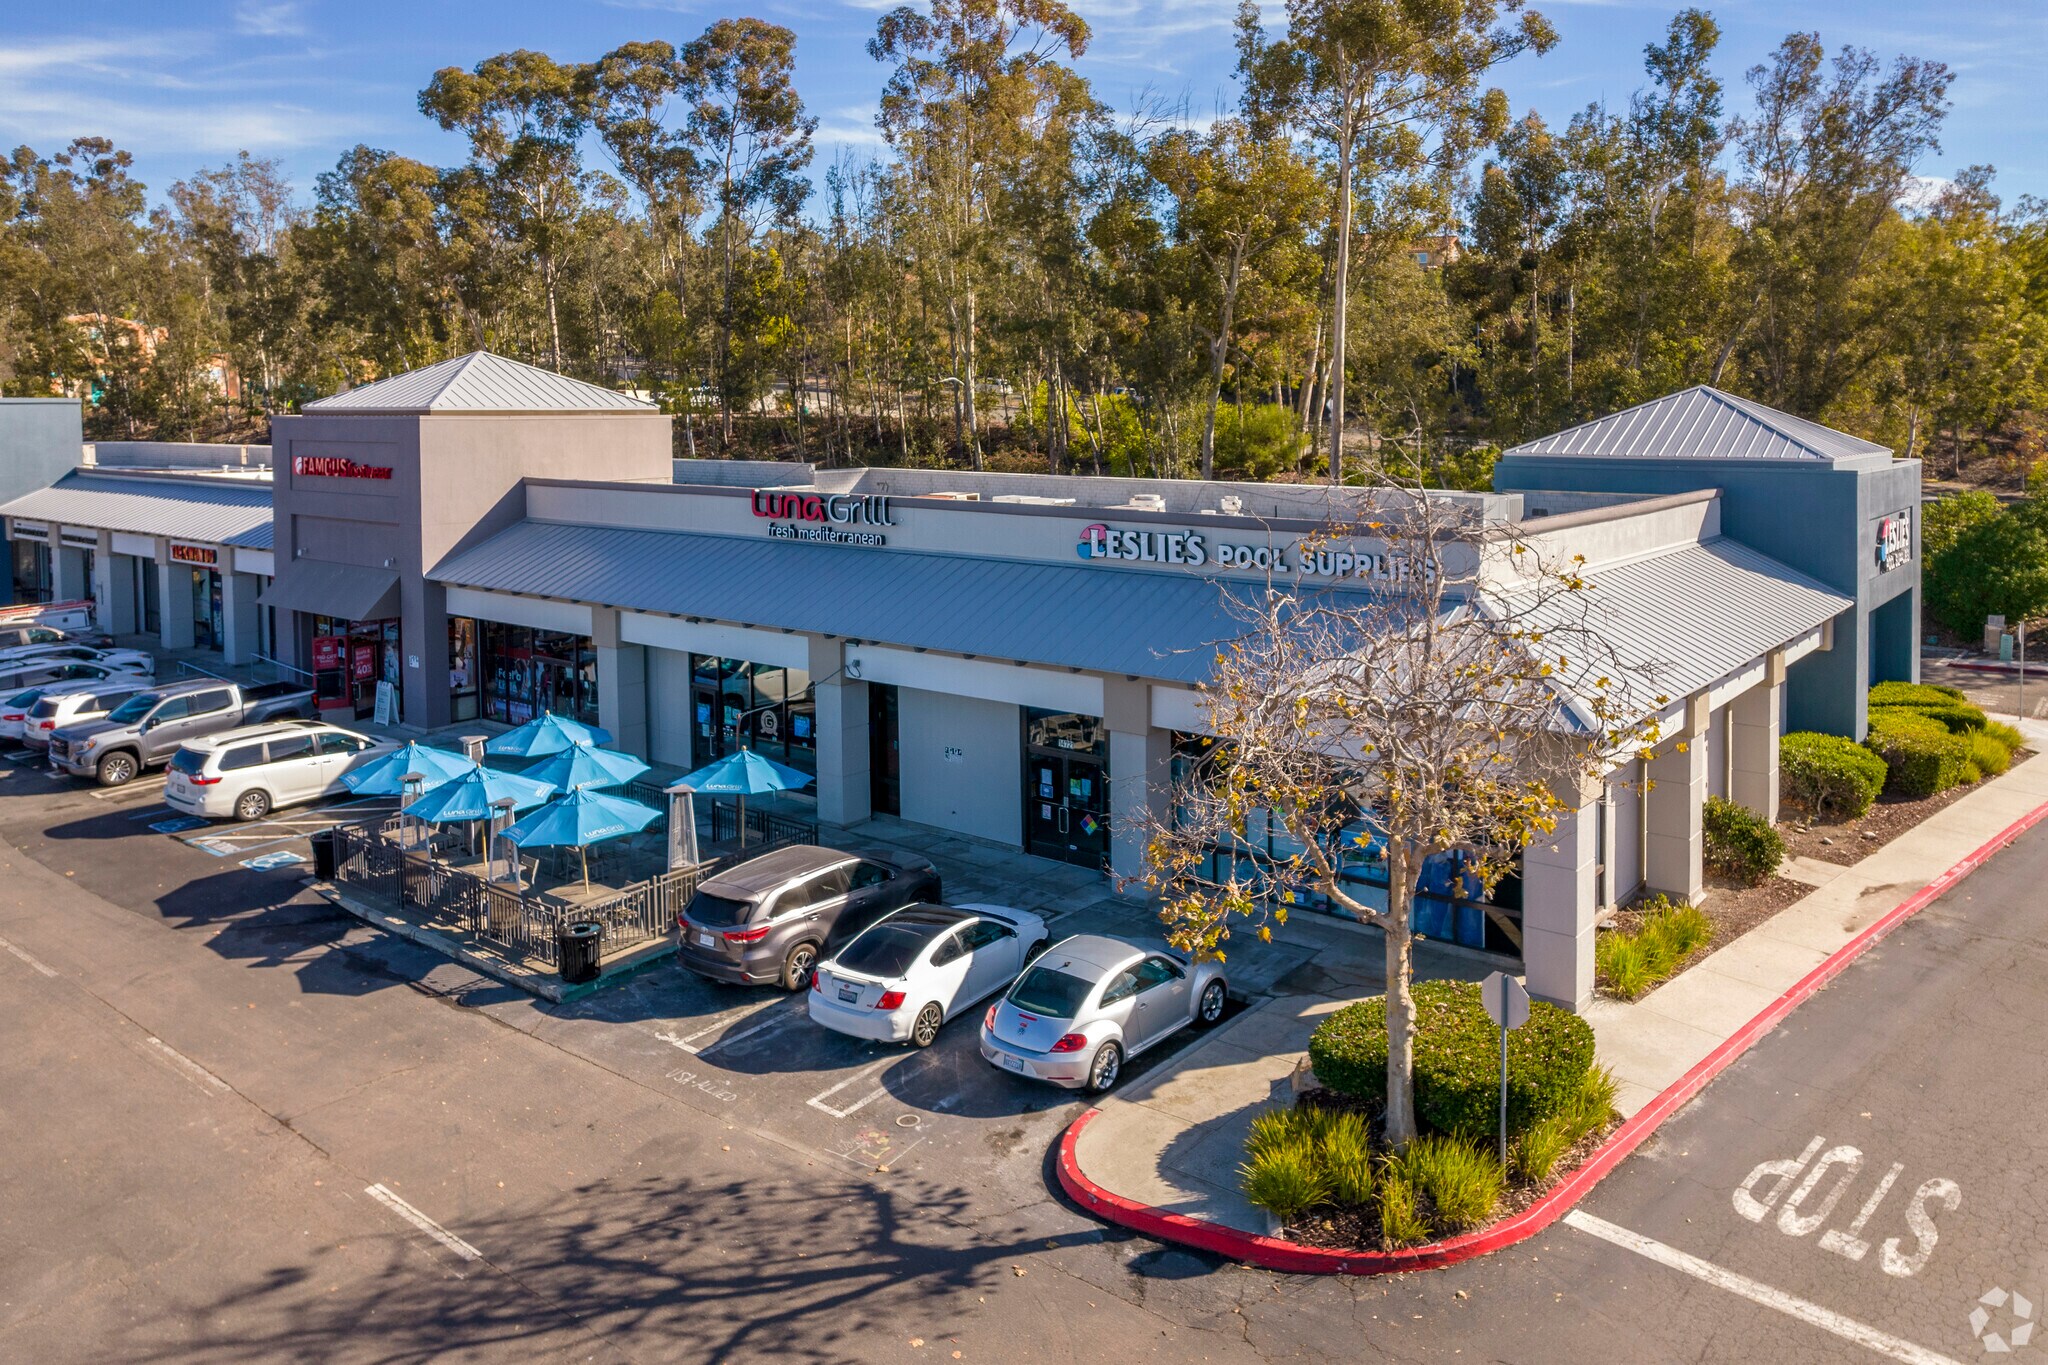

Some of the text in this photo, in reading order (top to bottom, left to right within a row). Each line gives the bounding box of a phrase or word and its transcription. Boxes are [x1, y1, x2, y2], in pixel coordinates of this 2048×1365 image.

[303, 457, 347, 477] FAMOUS
[767, 522, 884, 546] fresh mediterranean
[1090, 528, 1437, 584] LESLIE'S POOL SUPPLIES
[1732, 1135, 1962, 1278] STOP
